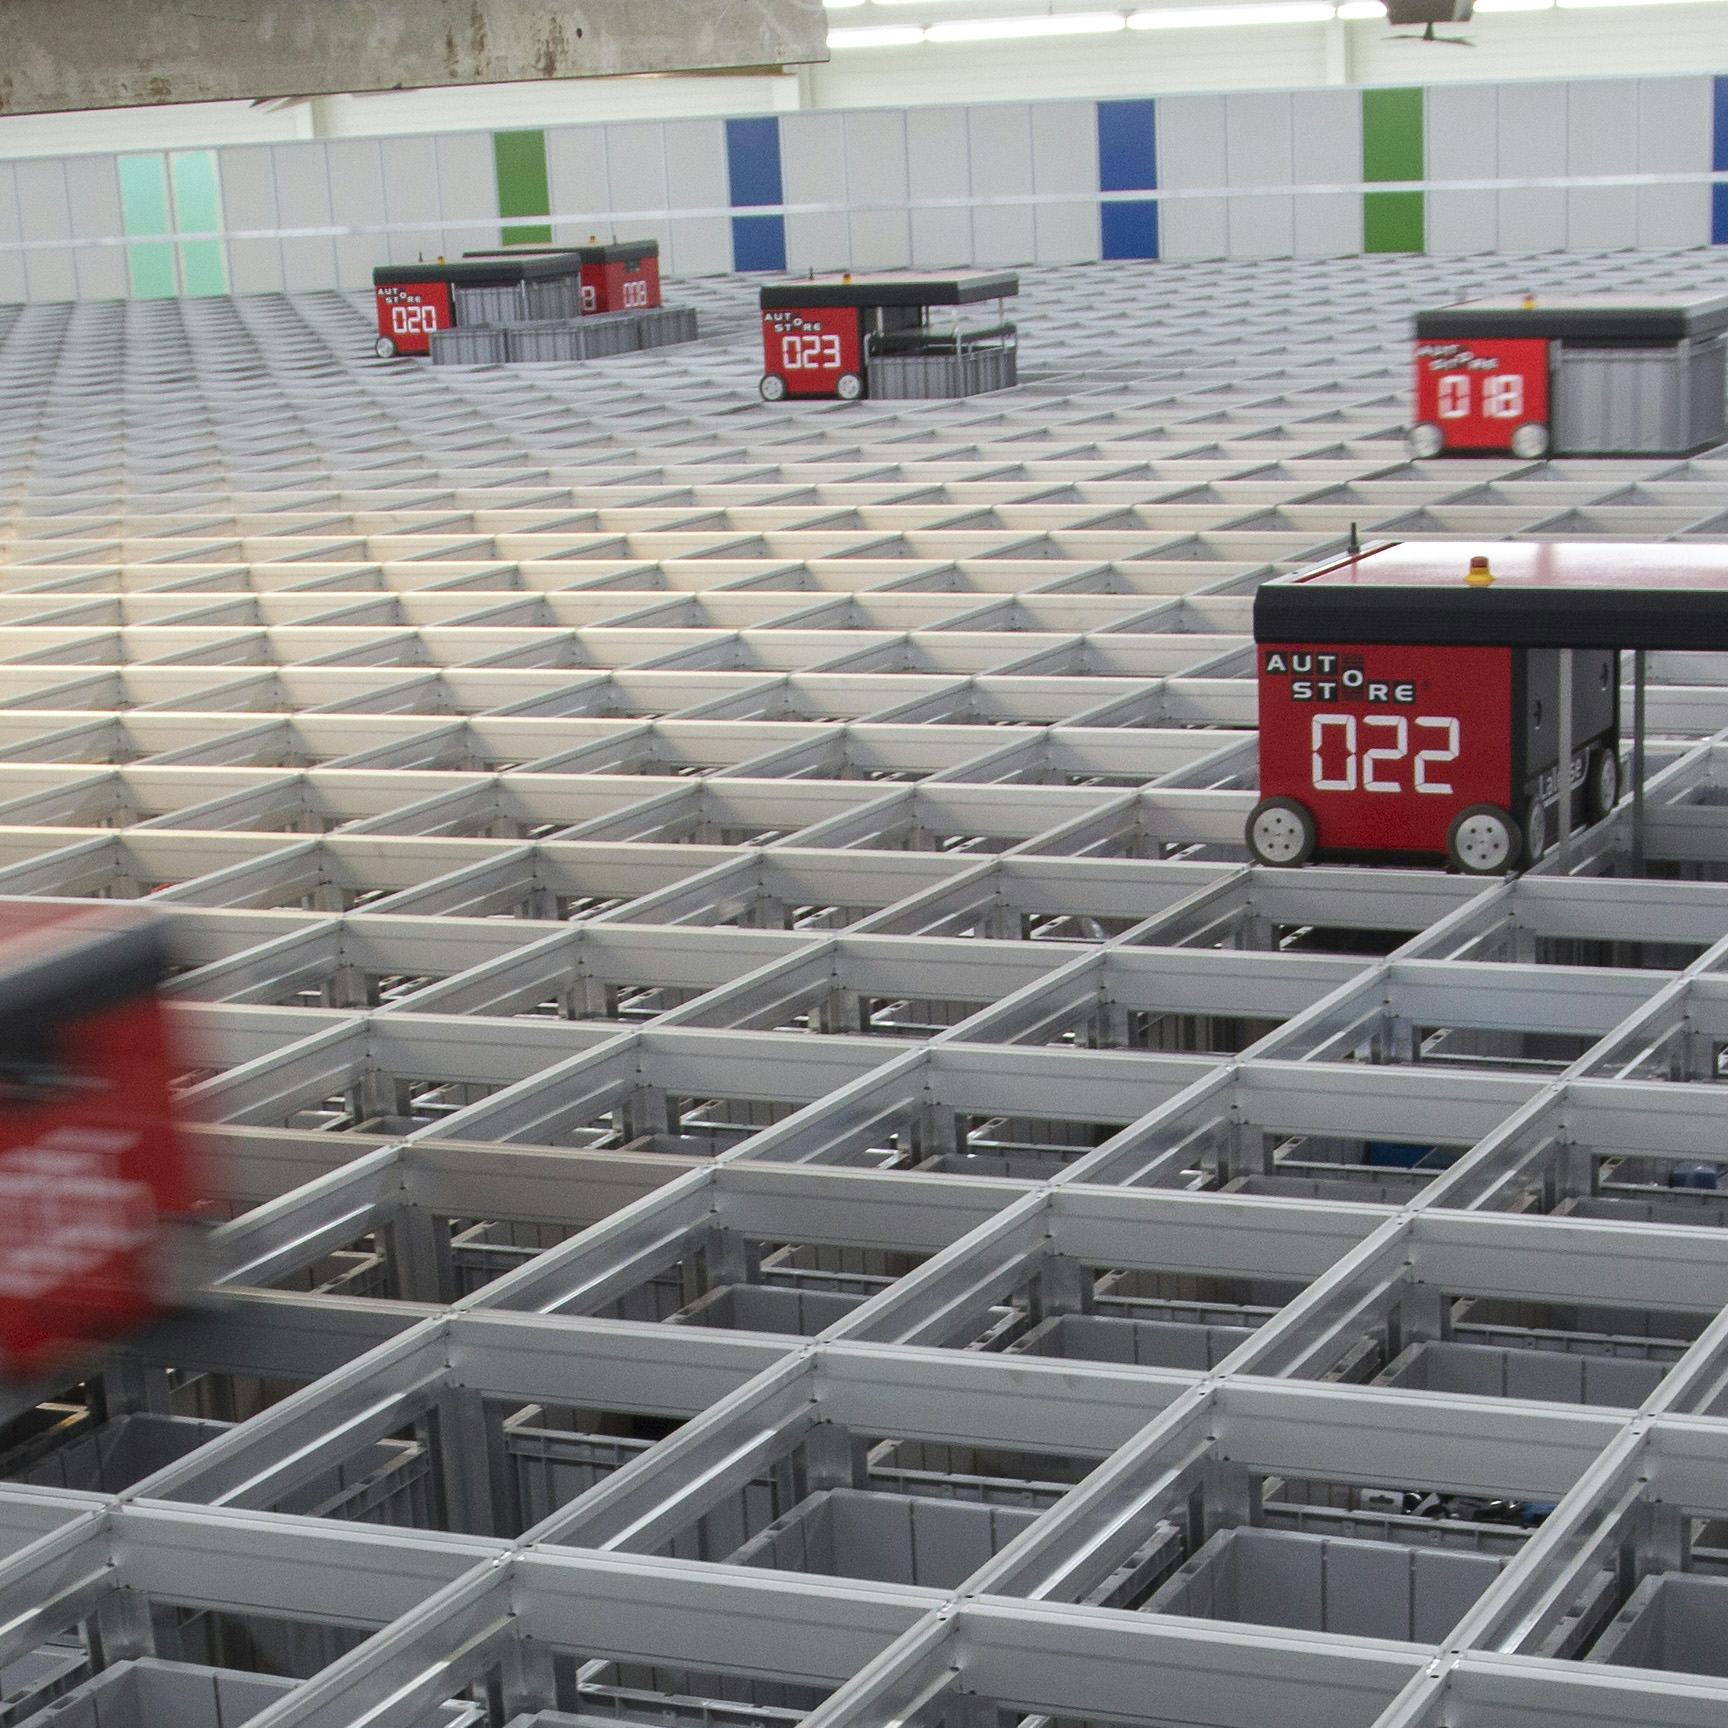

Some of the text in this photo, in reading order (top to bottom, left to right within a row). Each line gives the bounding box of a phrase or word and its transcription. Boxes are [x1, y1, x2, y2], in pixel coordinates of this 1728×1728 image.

[393, 306, 437, 333] 020
[783, 335, 841, 368] 023
[1312, 714, 1460, 794] 022
